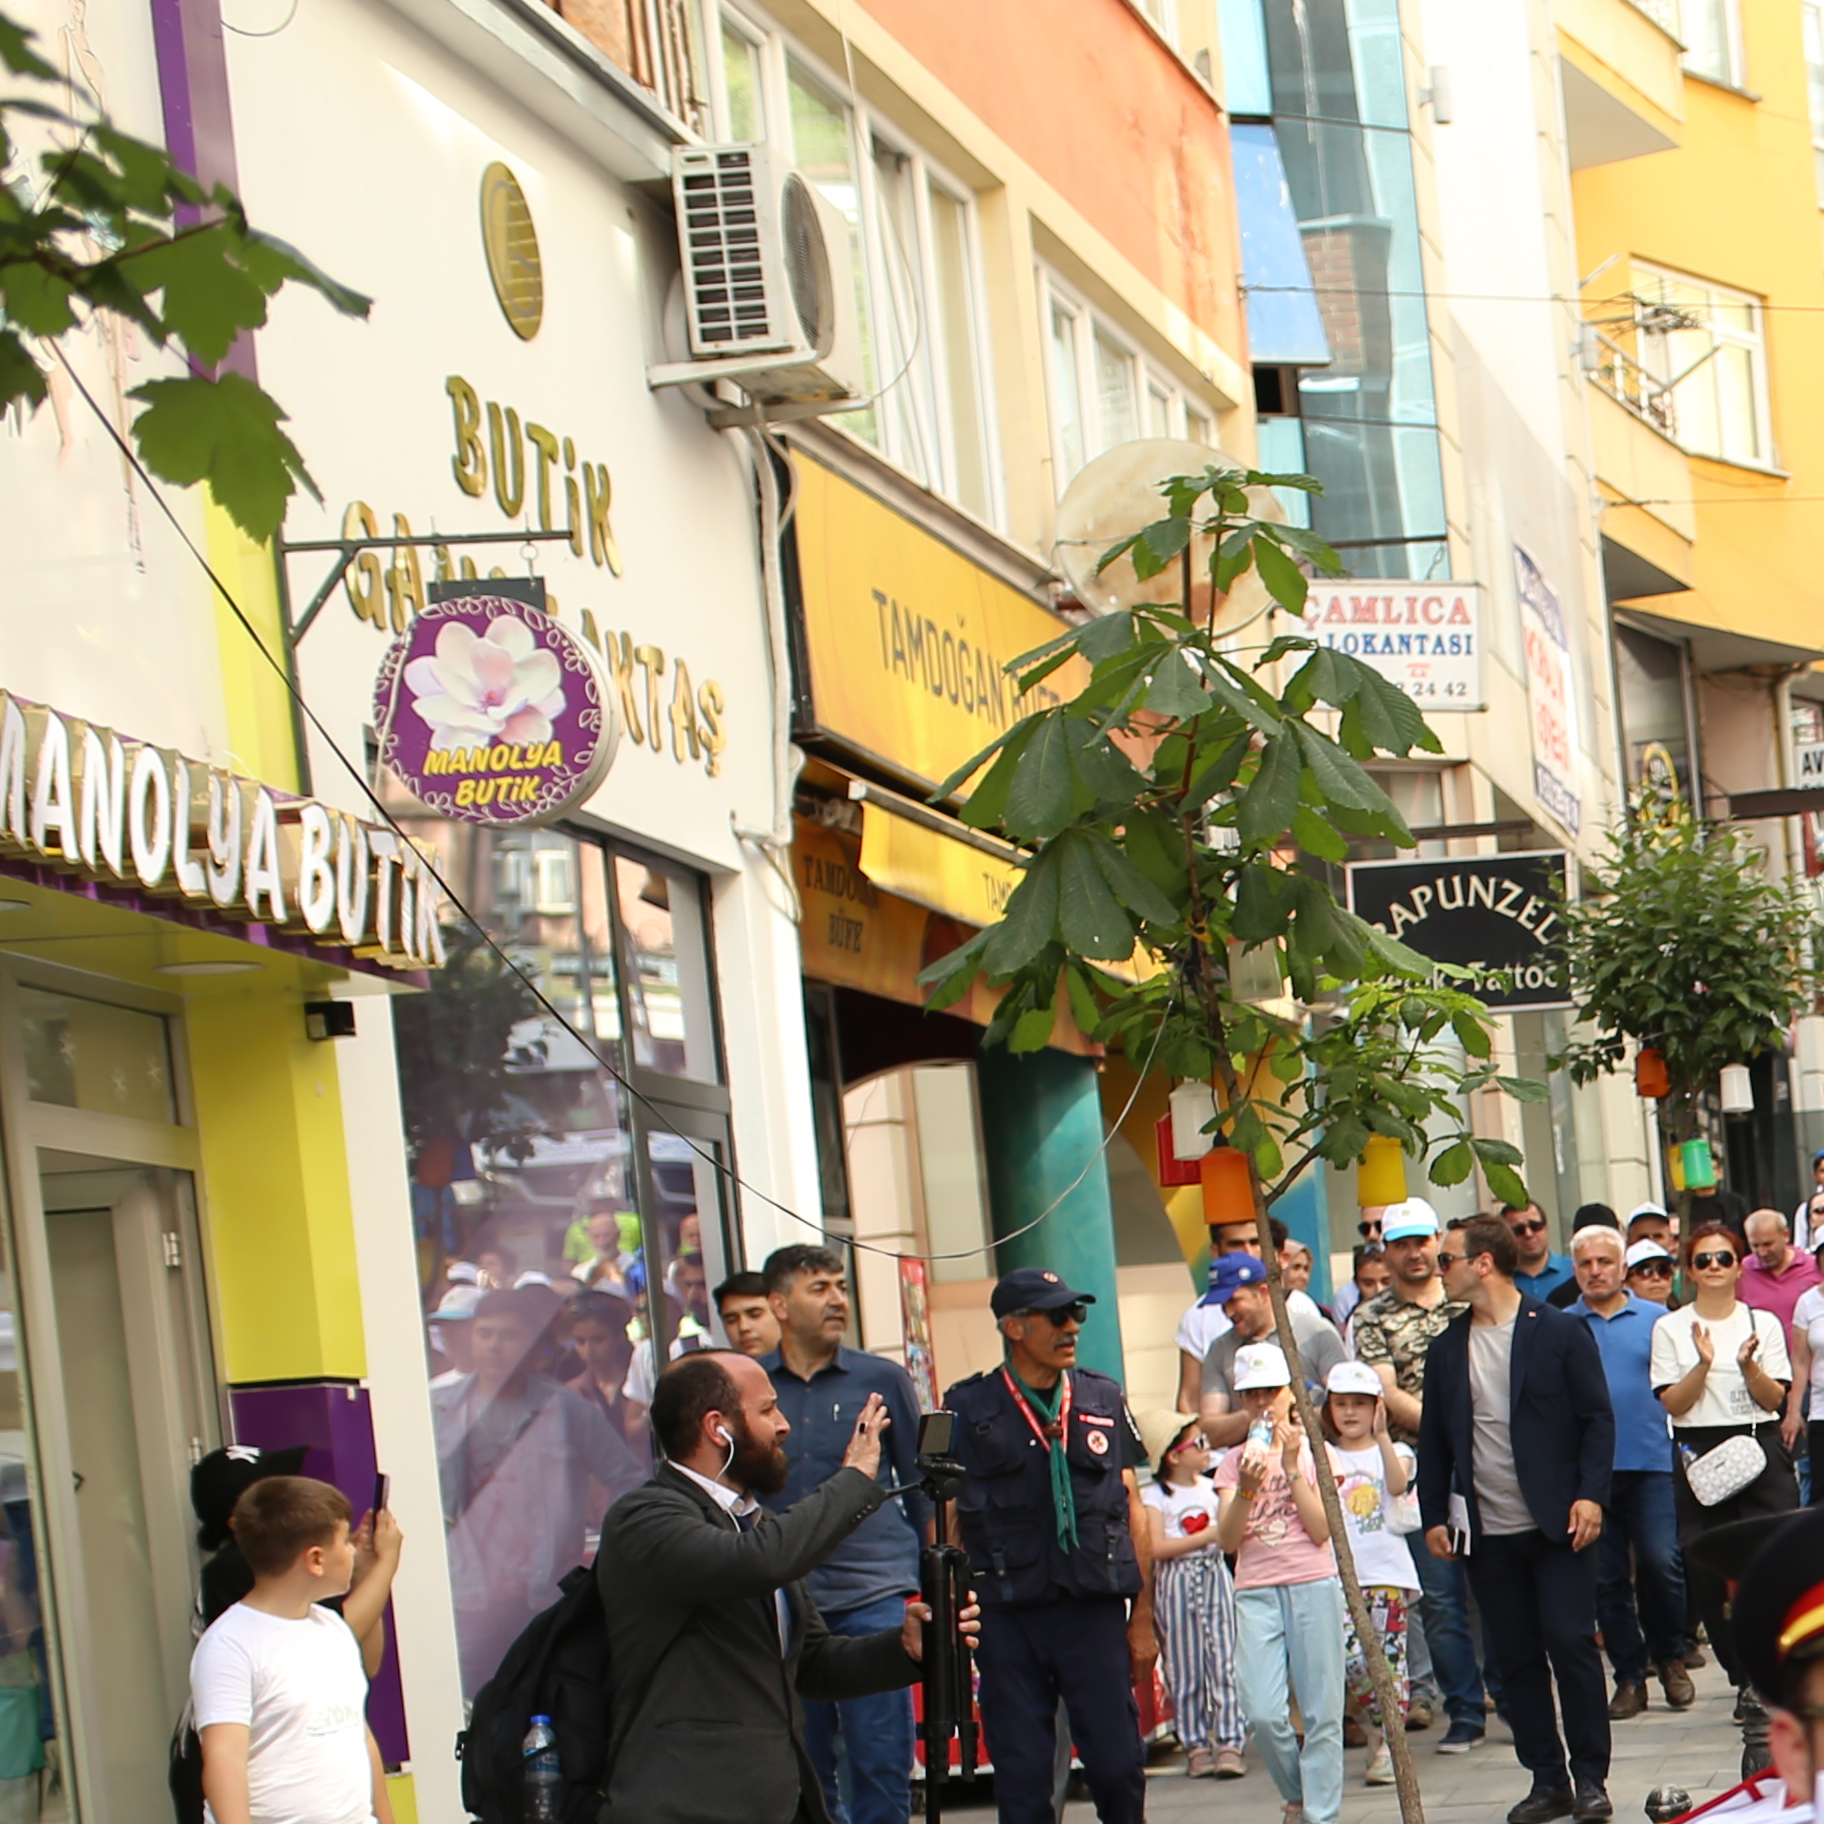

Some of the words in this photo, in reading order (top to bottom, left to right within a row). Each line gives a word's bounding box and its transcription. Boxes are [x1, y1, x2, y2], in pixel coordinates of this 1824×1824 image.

[446, 374, 622, 578] BUTİK
[1302, 596, 1472, 631] ÇAMLICA
[1327, 633, 1474, 656] LOKANTASI
[582, 609, 727, 778] KTAŞ
[871, 585, 1007, 734] TAMDOĞAN
[423, 741, 562, 776] MANOLYA
[455, 775, 541, 806] BUTİK
[298, 800, 447, 970] BUTİK
[1373, 873, 1559, 946] APUNZEL
